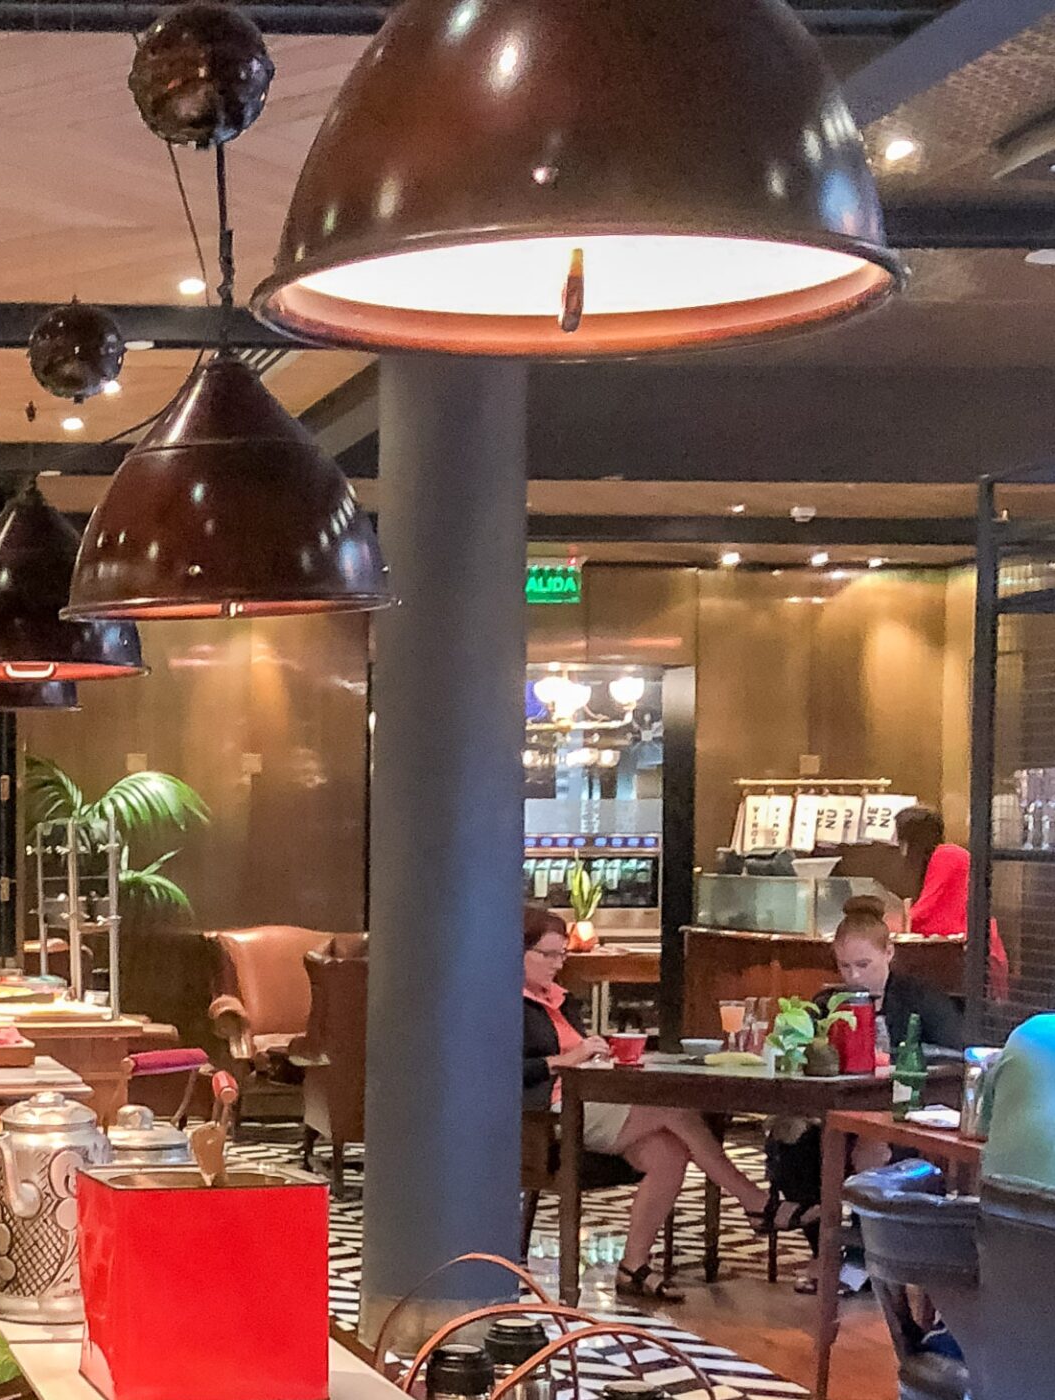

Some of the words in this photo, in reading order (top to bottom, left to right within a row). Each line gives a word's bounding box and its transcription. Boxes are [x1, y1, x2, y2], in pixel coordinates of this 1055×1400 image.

[525, 576, 577, 592] ALIDA
[825, 808, 838, 830] NU
[866, 806, 879, 827] ME
[879, 807, 892, 829] NU
